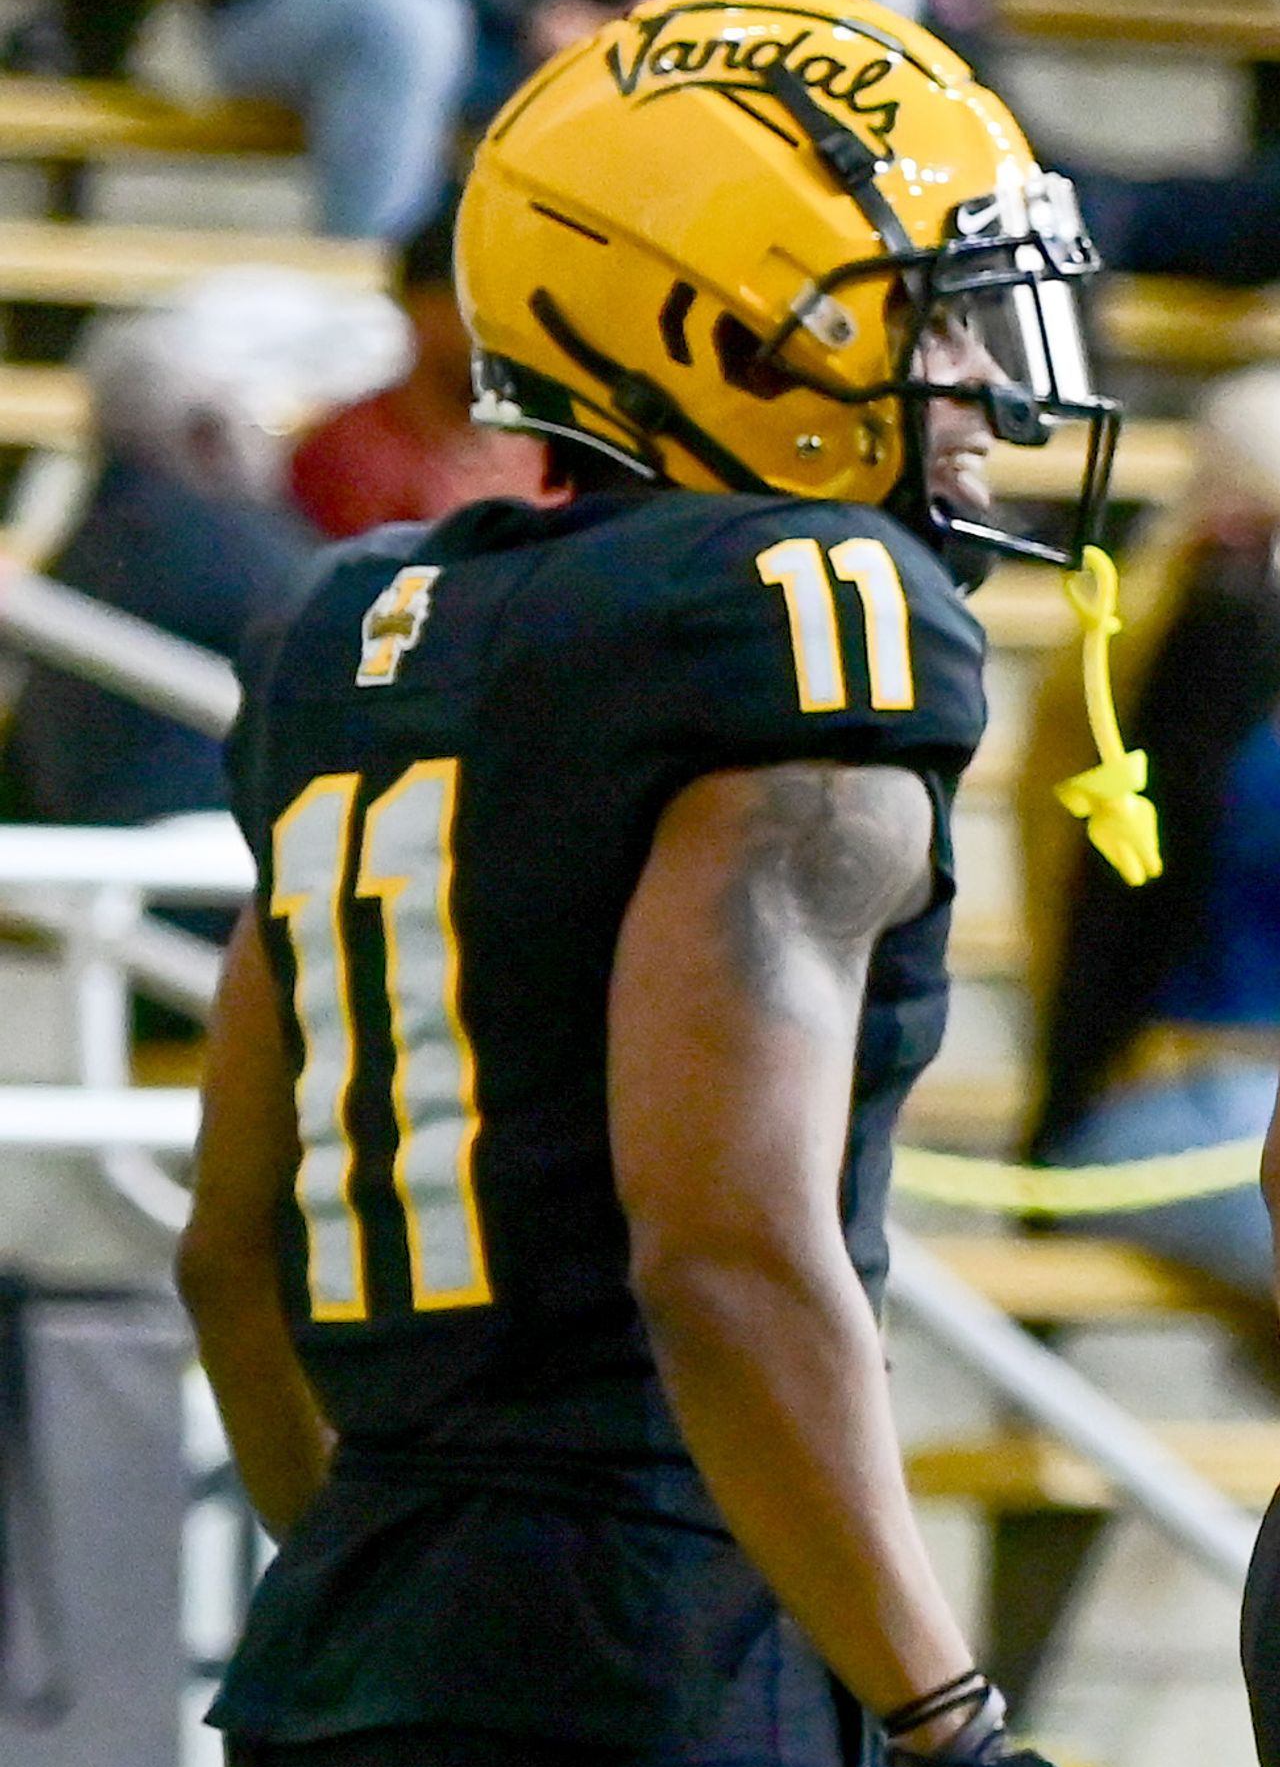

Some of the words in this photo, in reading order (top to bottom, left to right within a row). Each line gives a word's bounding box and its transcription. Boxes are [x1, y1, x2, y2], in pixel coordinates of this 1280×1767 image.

[606, 15, 898, 135] Vandals
[755, 537, 915, 714] 11
[270, 756, 492, 1323] 11
